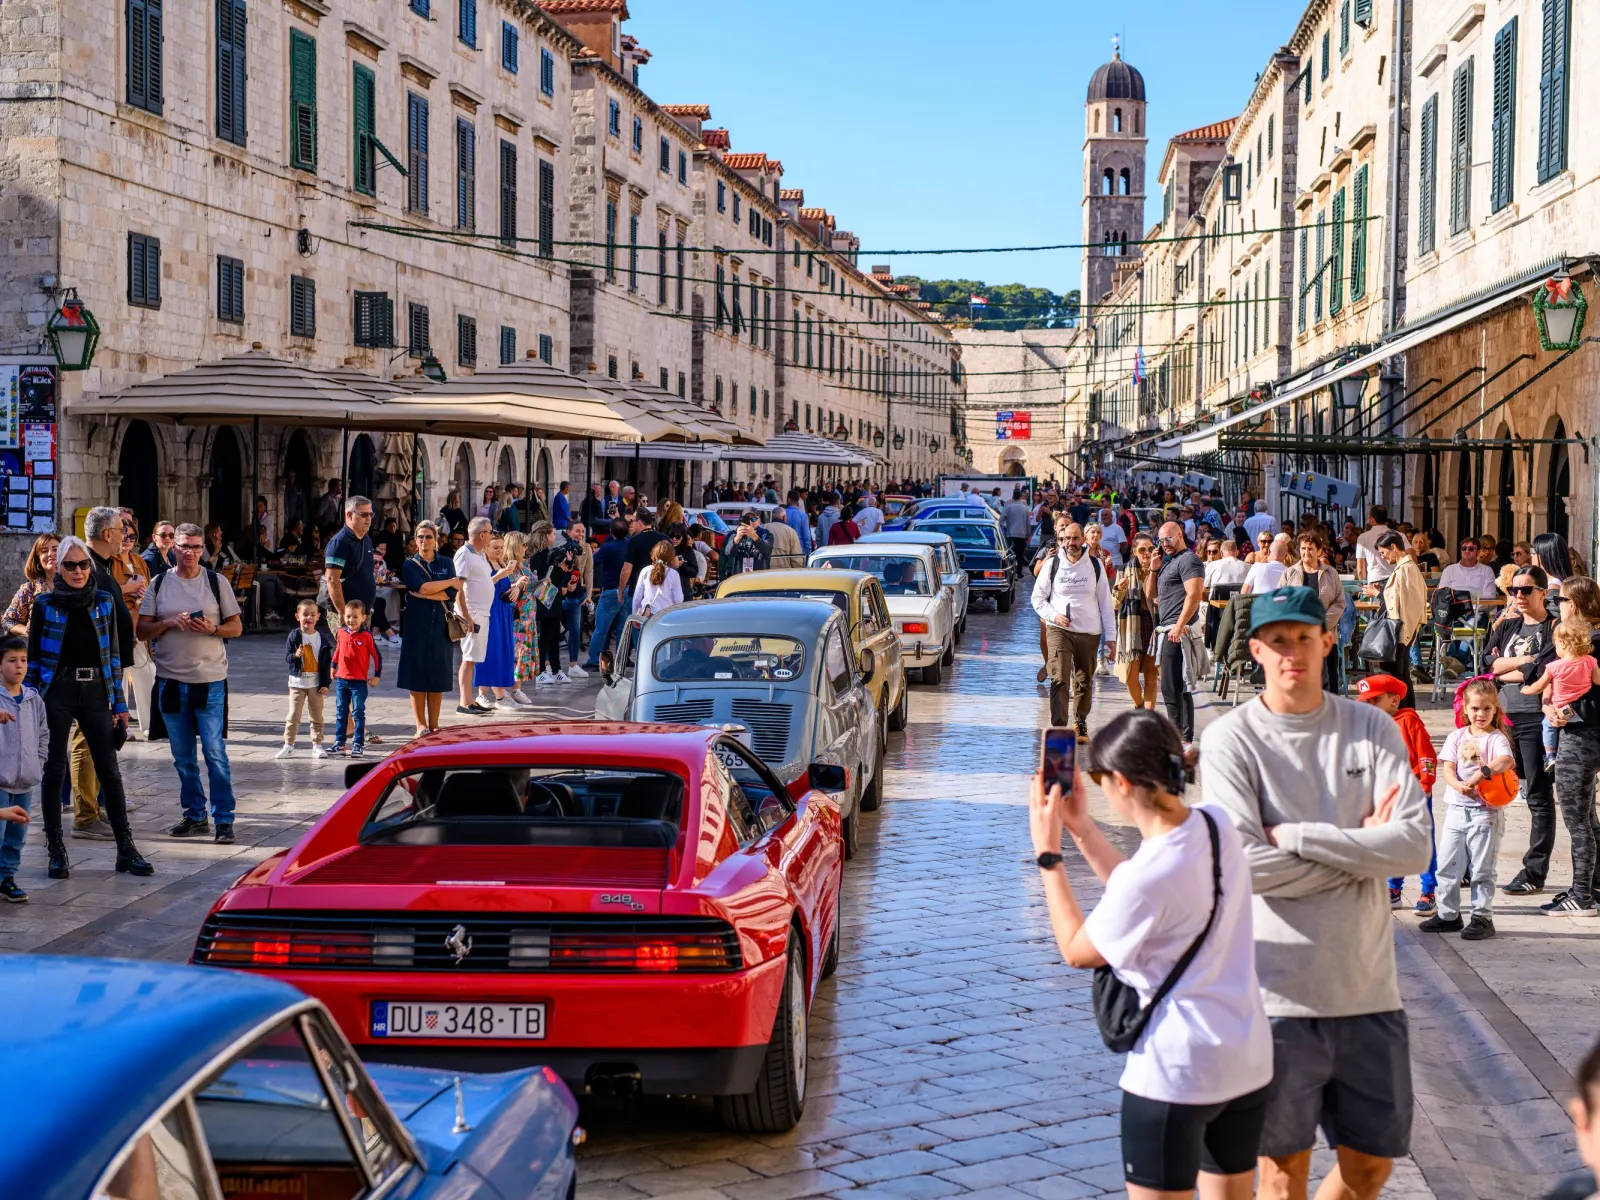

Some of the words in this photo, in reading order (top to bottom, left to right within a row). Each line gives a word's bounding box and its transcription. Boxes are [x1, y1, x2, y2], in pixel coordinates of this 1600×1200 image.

[1360, 682, 1369, 691] M
[600, 894, 632, 904] 348
[631, 901, 645, 911] tb
[391, 1005, 423, 1033] DU
[444, 1006, 541, 1035] 348-TB
[373, 1023, 386, 1032] HR
